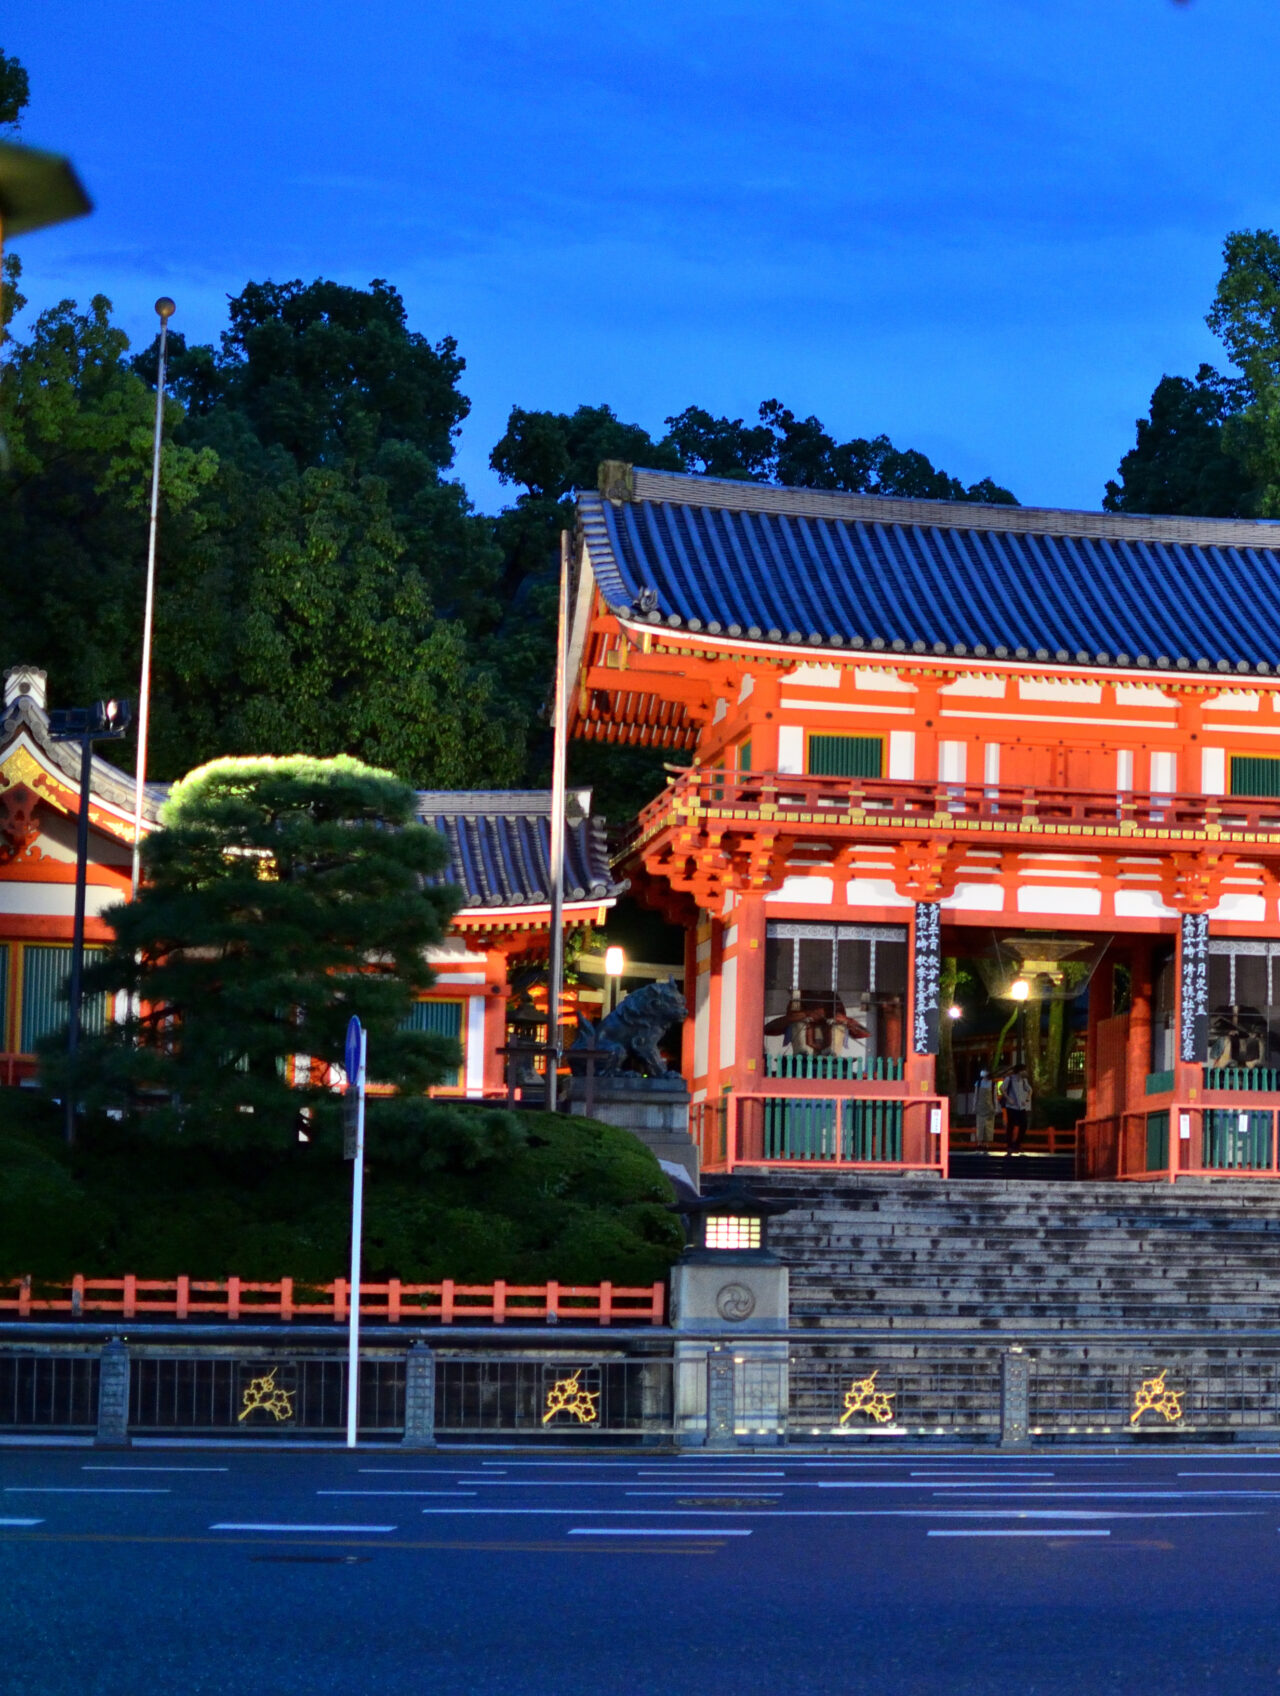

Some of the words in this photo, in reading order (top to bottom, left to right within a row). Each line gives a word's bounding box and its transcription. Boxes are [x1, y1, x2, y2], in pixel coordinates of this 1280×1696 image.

[915, 902, 929, 952] 午前十時
[1182, 913, 1196, 959] 午前十時
